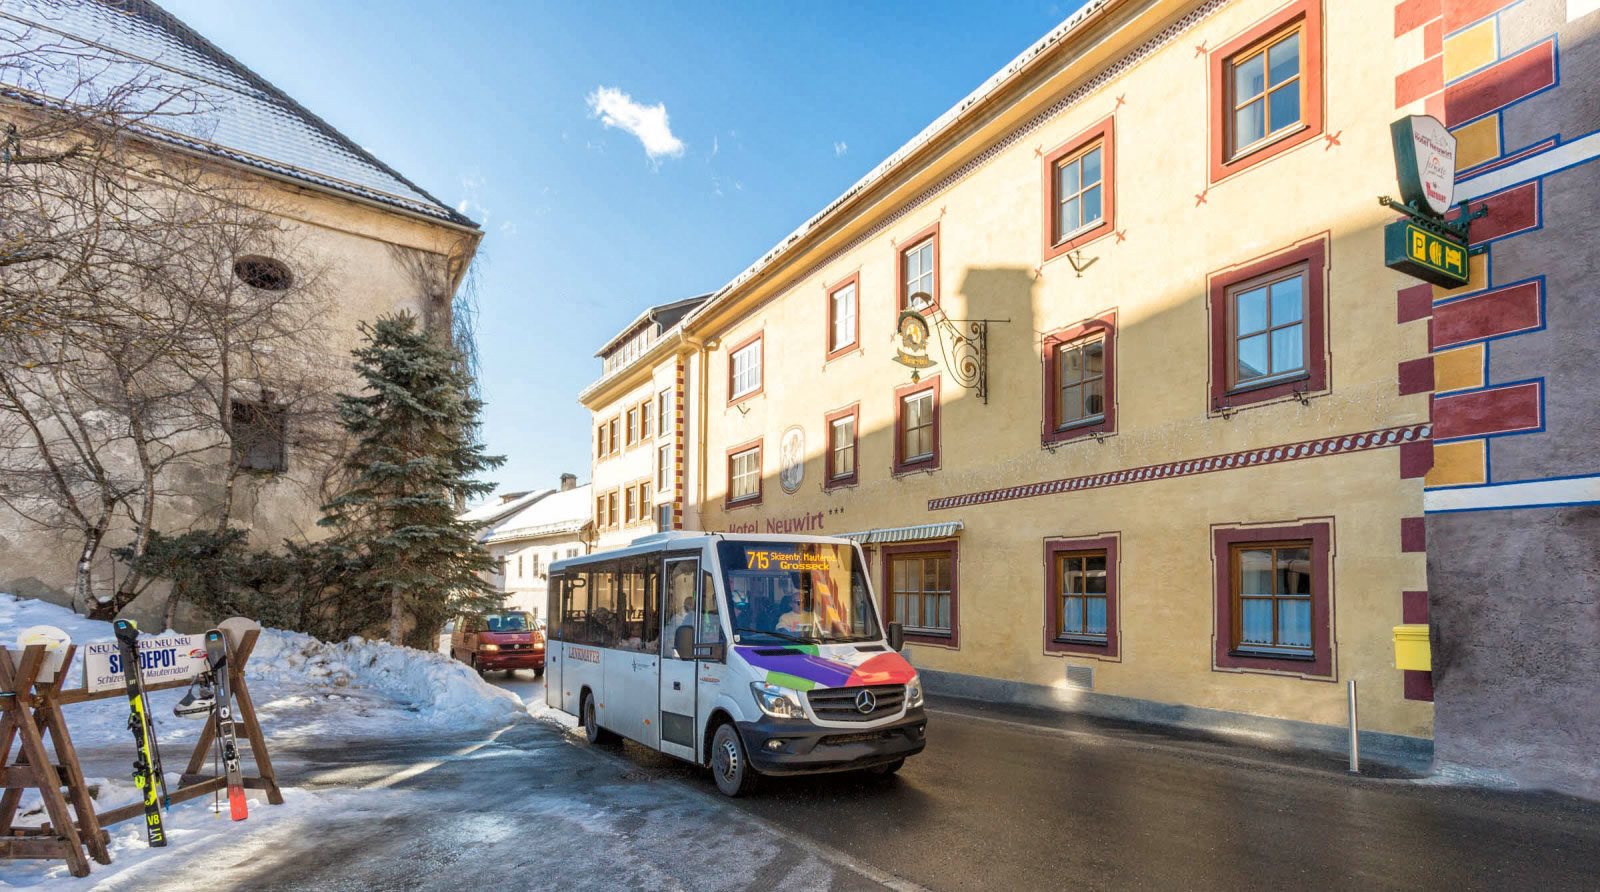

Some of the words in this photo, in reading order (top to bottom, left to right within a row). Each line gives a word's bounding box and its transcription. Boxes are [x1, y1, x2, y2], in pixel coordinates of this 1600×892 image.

[729, 520, 759, 533] Hotel
[766, 511, 824, 534] Neuwirt
[747, 551, 769, 569] 715
[780, 561, 830, 570] Grosseck
[89, 645, 110, 653] NEU
[155, 638, 172, 647] NEU
[174, 636, 191, 645] NEU
[139, 648, 177, 670] DEPOT
[146, 665, 190, 678] Mauterndorf
[147, 815, 160, 826] V8
